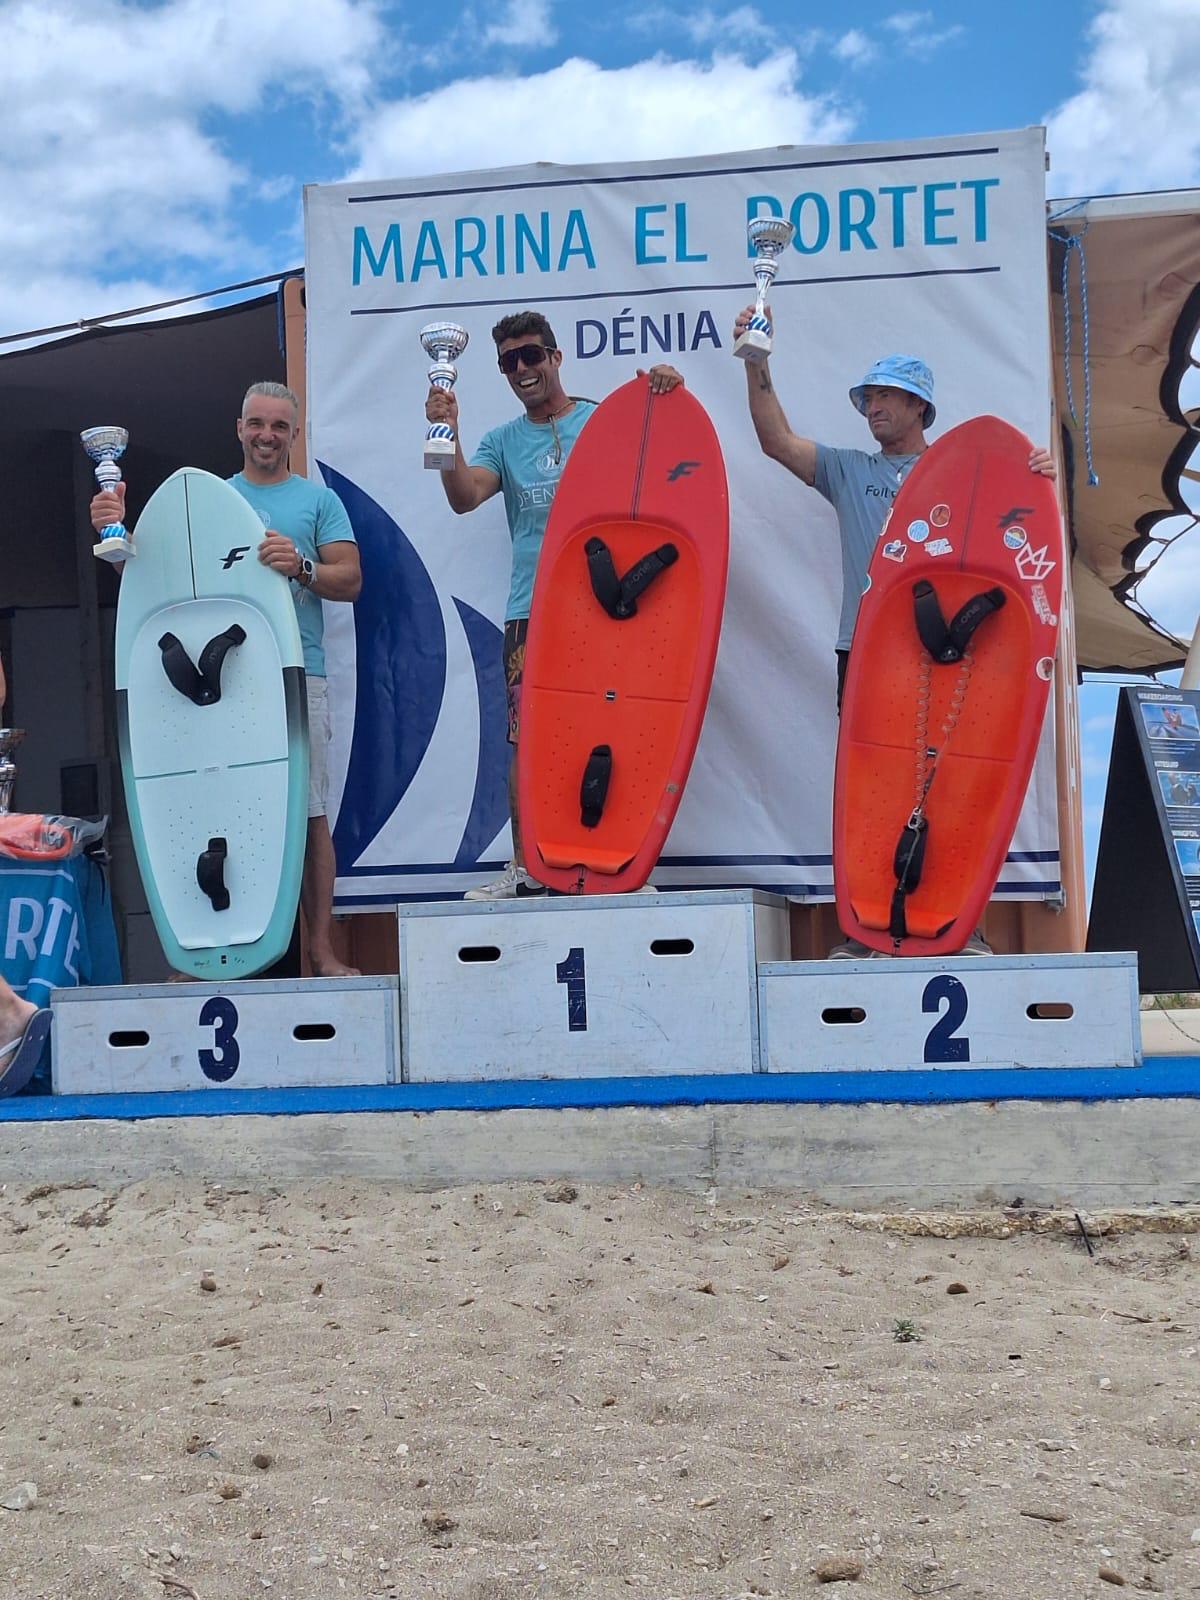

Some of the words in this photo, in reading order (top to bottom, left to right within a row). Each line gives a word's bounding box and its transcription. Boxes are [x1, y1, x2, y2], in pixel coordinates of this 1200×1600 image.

[352, 209, 597, 286] MARINA
[634, 203, 708, 265] EL
[576, 308, 722, 359] DÉNIA
[556, 947, 588, 1032] 1
[921, 974, 971, 1063] 2
[197, 996, 241, 1083] 3
